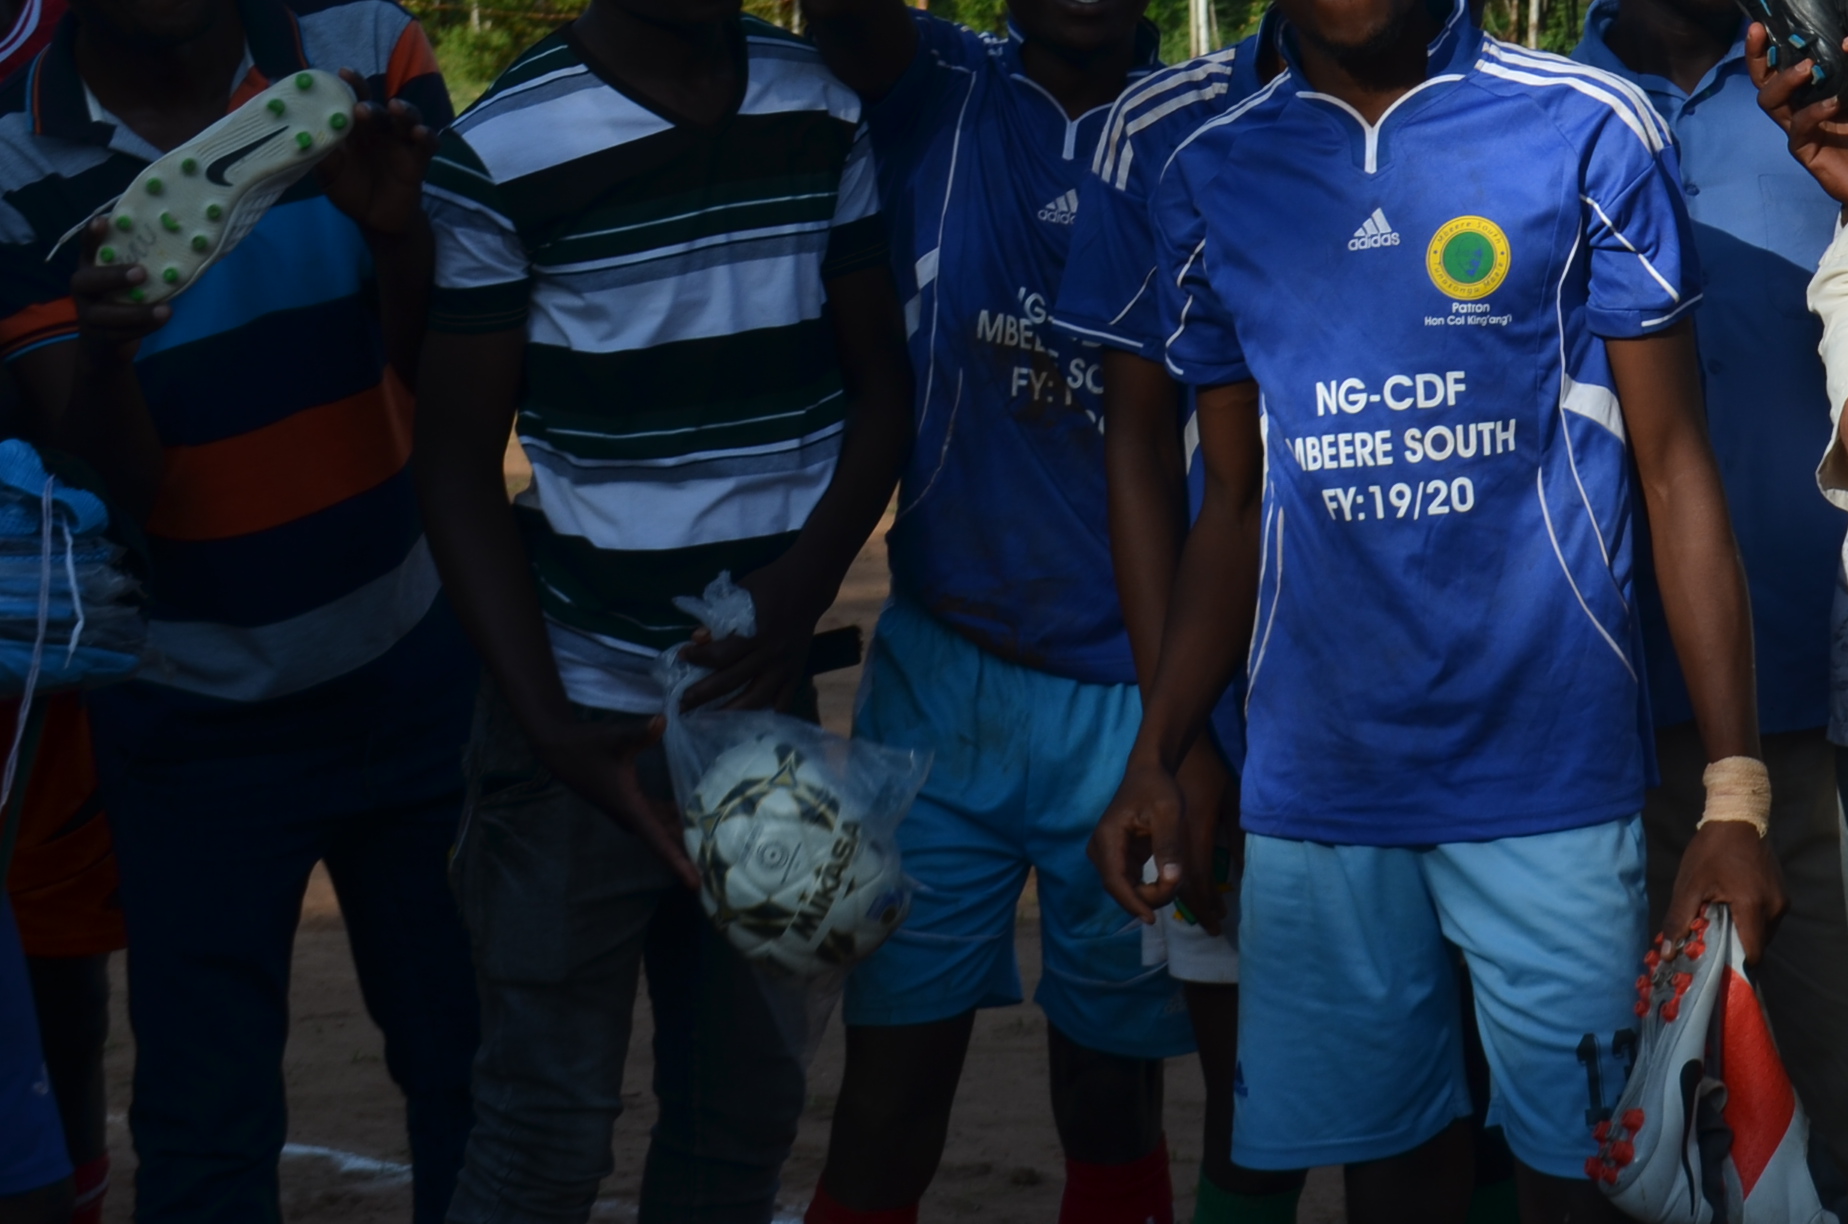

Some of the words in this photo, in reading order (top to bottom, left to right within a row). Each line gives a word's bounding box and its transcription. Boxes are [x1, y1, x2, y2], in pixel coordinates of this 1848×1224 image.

[1348, 232, 1400, 251] adidas
[1477, 221, 1502, 245] South
[1424, 315, 1444, 326] Hon
[1447, 315, 1465, 326] Col
[1451, 302, 1490, 314] Patron
[1315, 370, 1467, 417] NG-CDF
[1403, 418, 1517, 464] SOUTH
[1321, 476, 1475, 521] FY:19/20
[791, 821, 860, 944] MIKASA
